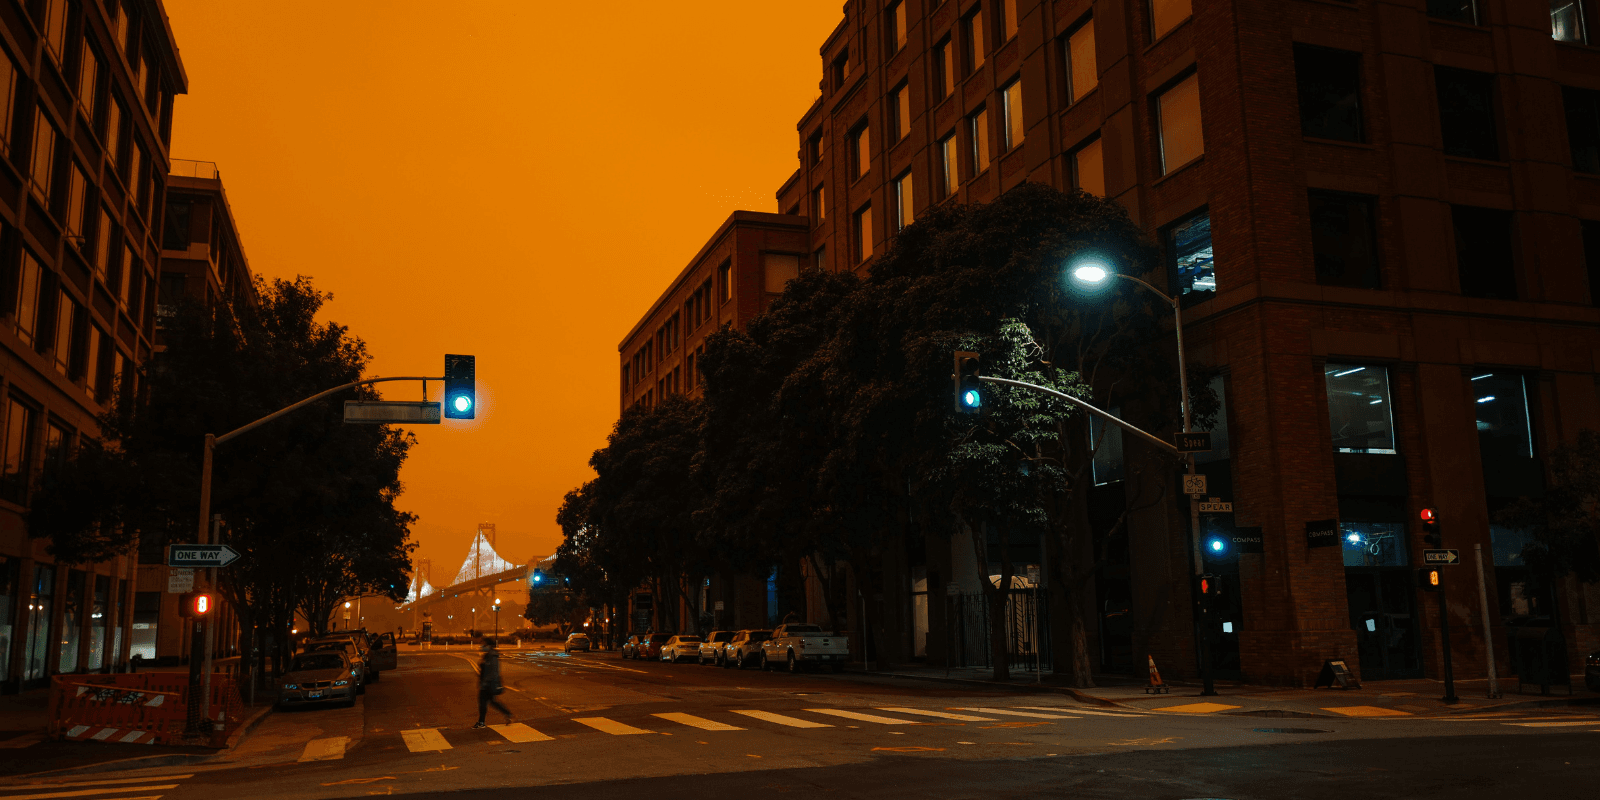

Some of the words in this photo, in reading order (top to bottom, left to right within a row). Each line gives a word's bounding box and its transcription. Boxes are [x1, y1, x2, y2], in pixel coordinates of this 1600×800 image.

[1184, 437, 1205, 449] Spear
[1308, 529, 1334, 538] COMPASS
[177, 551, 197, 560] ONE
[200, 551, 220, 560] WAY
